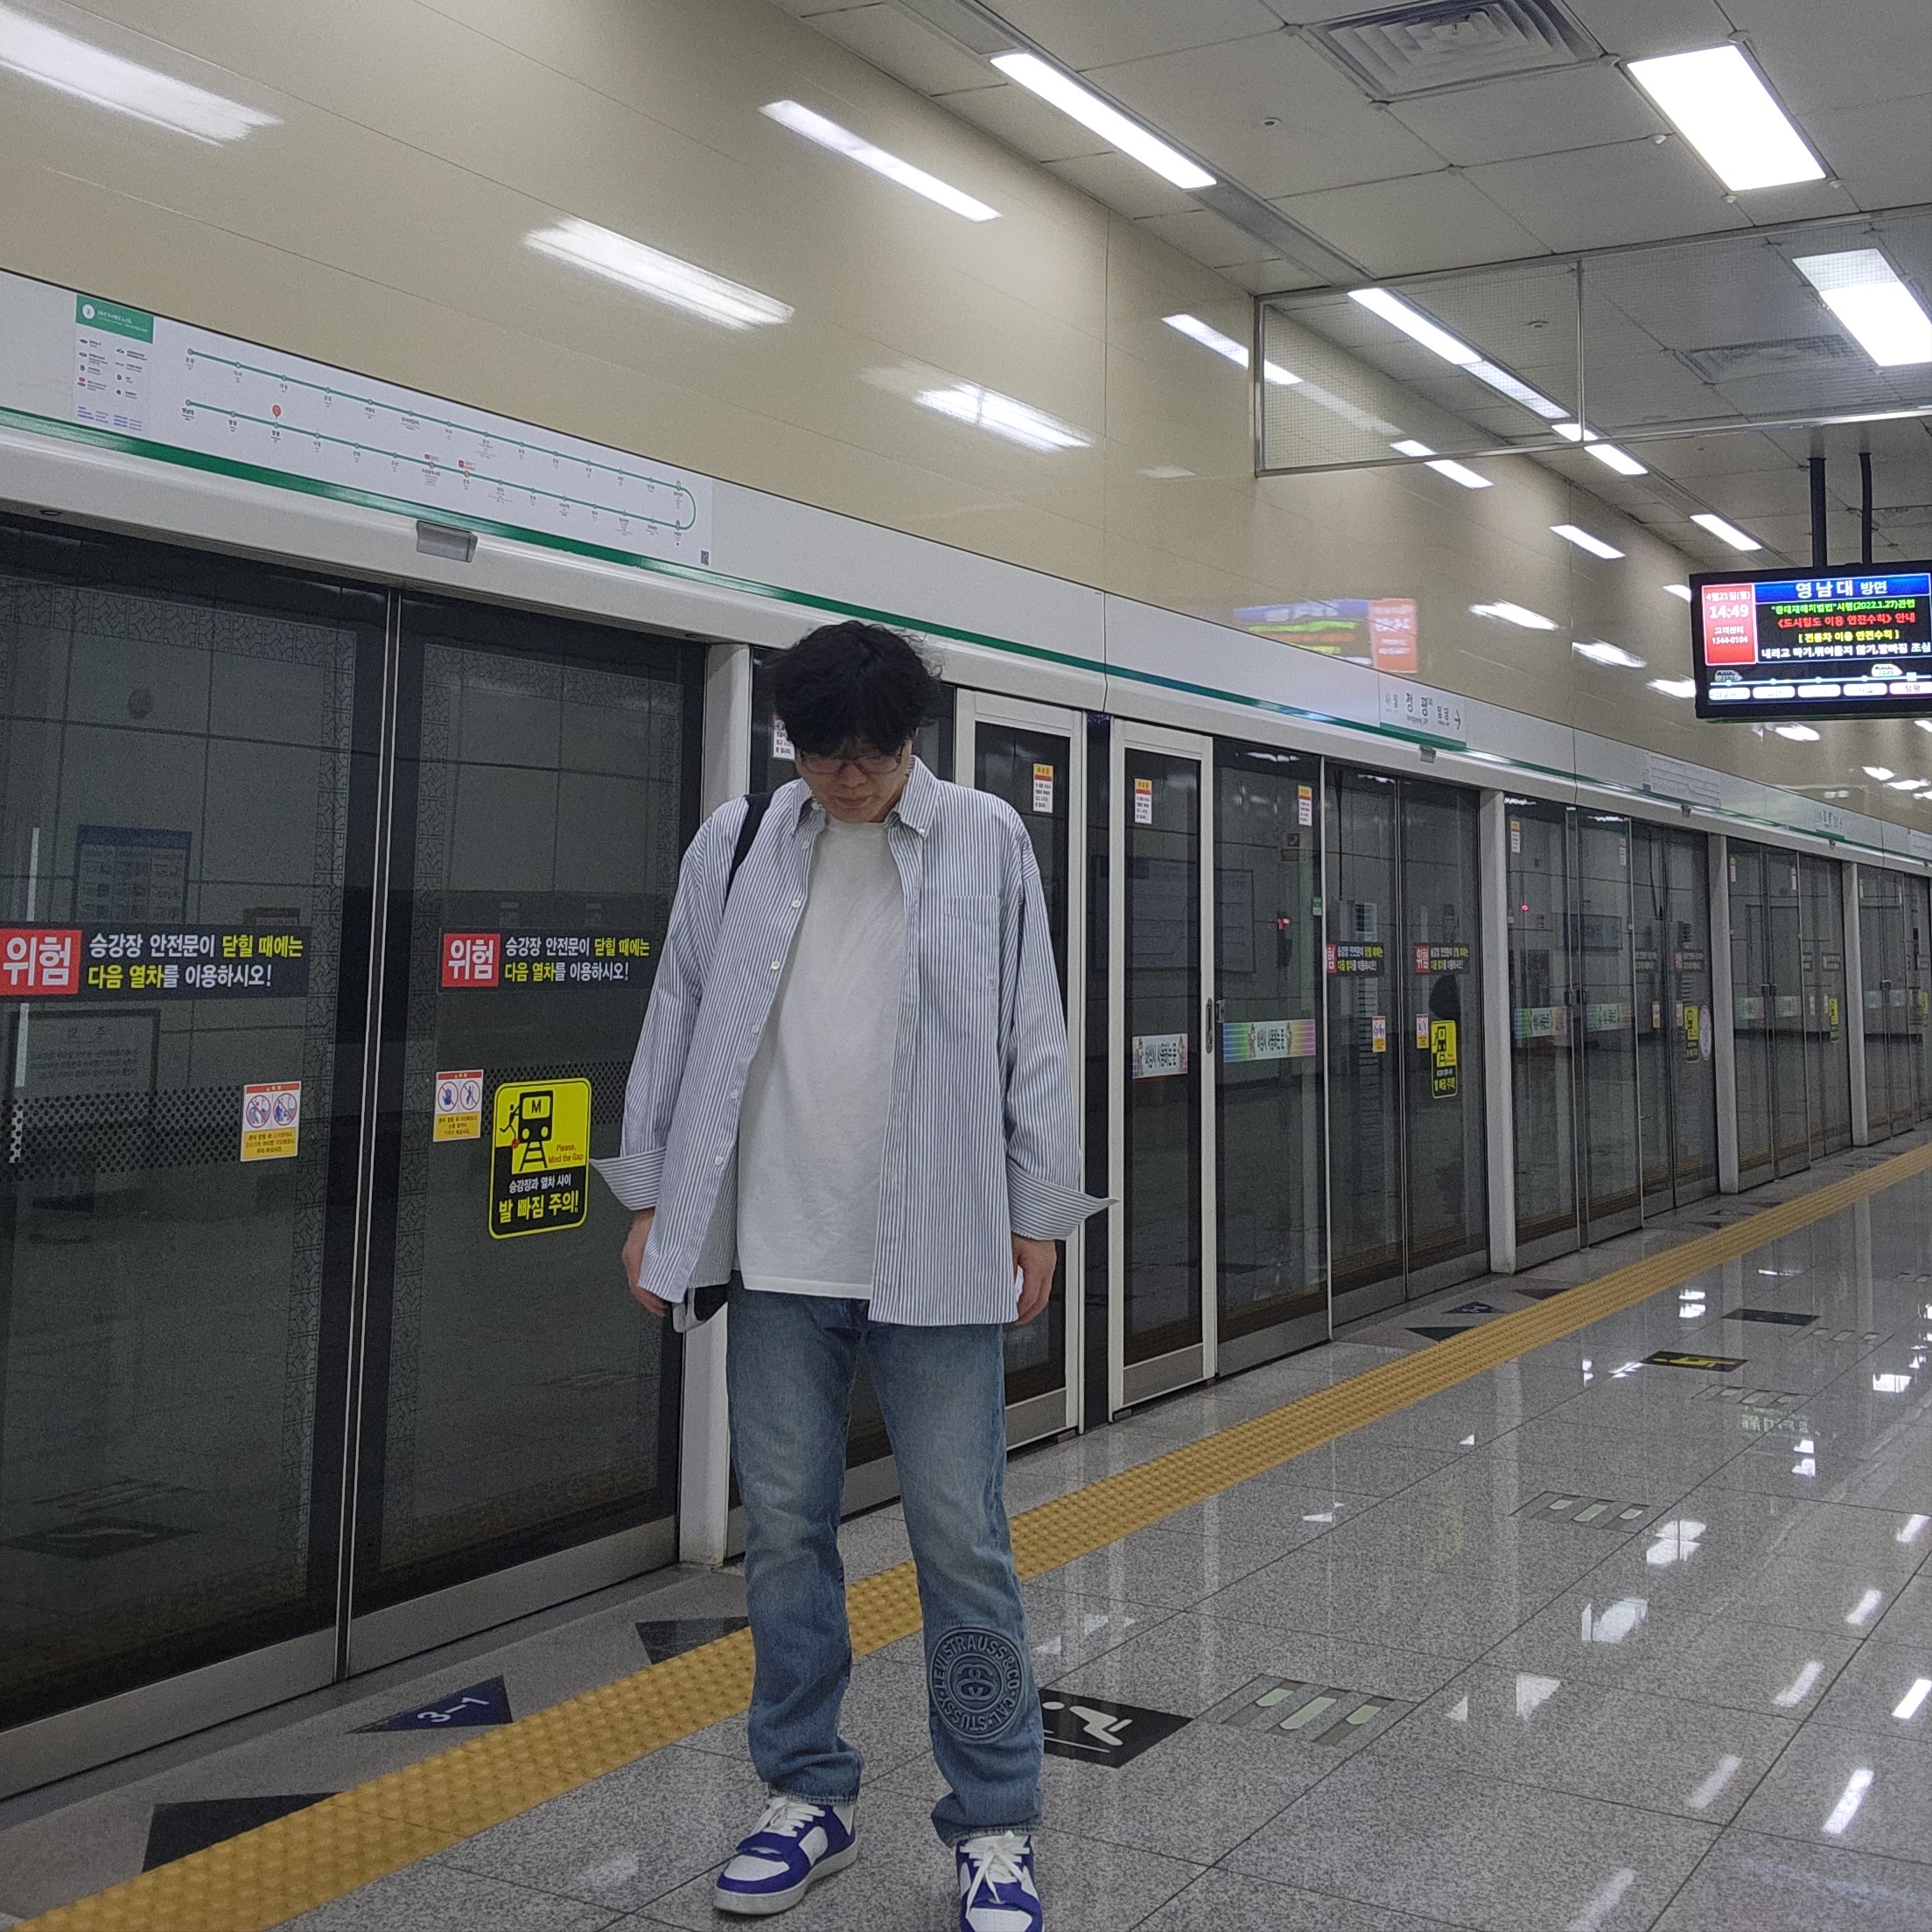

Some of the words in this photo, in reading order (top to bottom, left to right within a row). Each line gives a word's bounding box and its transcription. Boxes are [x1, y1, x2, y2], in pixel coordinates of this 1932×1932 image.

[1860, 580, 1888, 595] 방면
[1709, 604, 1749, 619] 14:49
[1824, 615, 1844, 626] 이용
[1894, 612, 1915, 624] 안내
[1834, 631, 1853, 641] 이용
[1761, 648, 1791, 659] 내리고
[1406, 692, 1428, 717] 정평
[88, 933, 144, 959] 승강장
[149, 934, 216, 959] 안전문이
[221, 934, 254, 959] 닫힐
[258, 934, 304, 958] 때에는
[505, 936, 542, 957] 승강장
[545, 936, 590, 957] 안전문이
[594, 937, 616, 957] 닫힐
[619, 937, 650, 956] 때에는
[2, 935, 72, 987] 위험
[448, 939, 494, 980] 위험
[1326, 947, 1335, 970] 험
[1417, 948, 1429, 970] 위험
[88, 964, 123, 990] 다음
[129, 963, 180, 989] 열차를
[185, 963, 272, 989] 이용하시오!
[504, 962, 529, 983] 다음
[532, 961, 566, 982] 열차를
[570, 961, 629, 982] 이용하시오!
[1157, 1042, 1172, 1068] 사용하는
[531, 1099, 542, 1114] M
[548, 1155, 562, 1164] Mind
[571, 1152, 584, 1163] Gap
[556, 1143, 578, 1152] Please,
[508, 1177, 539, 1194] 승강장과
[540, 1174, 556, 1189] 열차
[498, 1199, 514, 1225] 발
[517, 1194, 544, 1221] 빠짐
[548, 1189, 579, 1217] 주의!
[416, 1696, 490, 1723] 3-1
